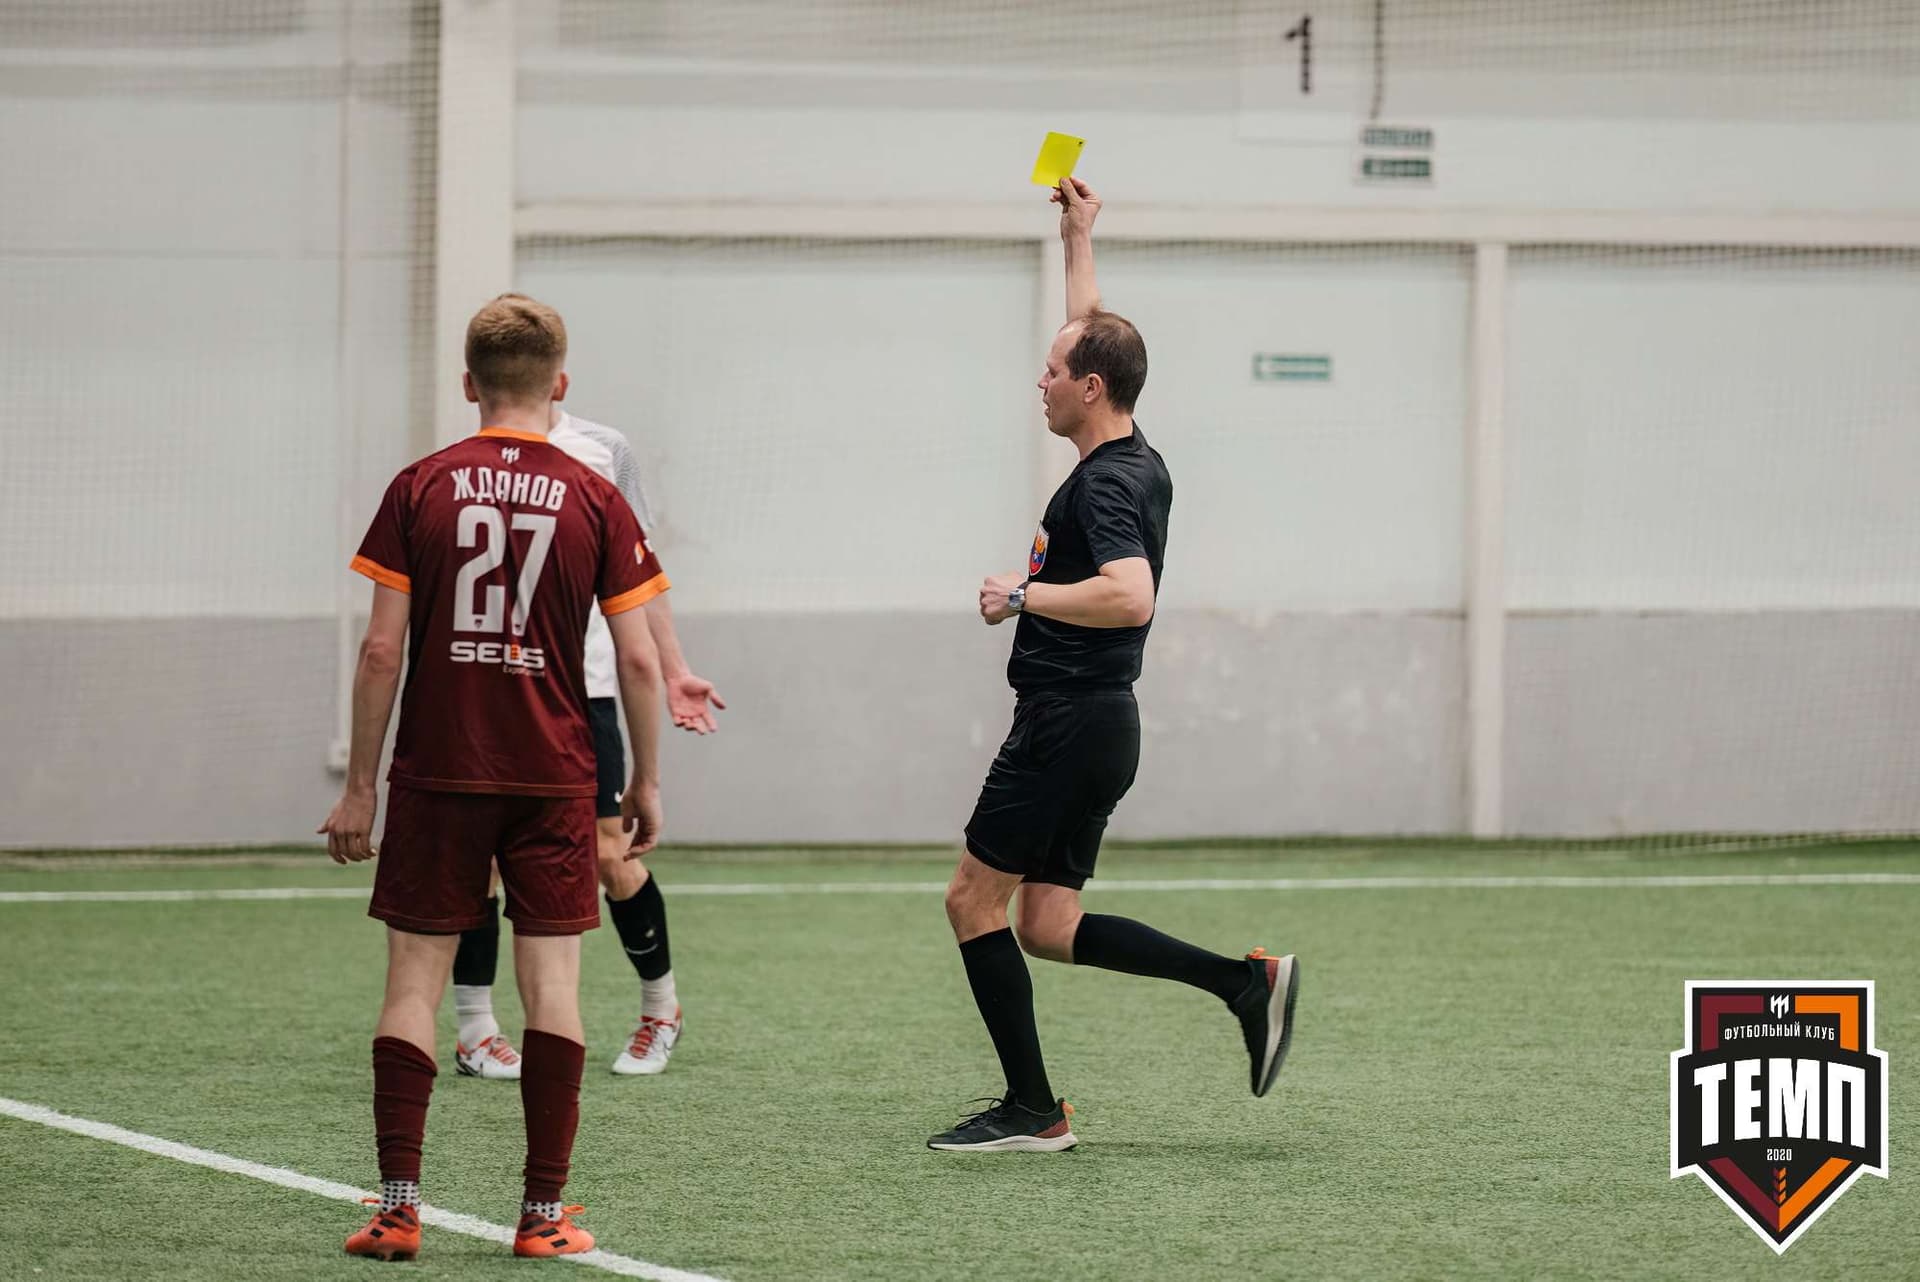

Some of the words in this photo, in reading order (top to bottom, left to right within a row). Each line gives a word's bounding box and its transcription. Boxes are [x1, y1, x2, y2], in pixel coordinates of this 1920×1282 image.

[1284, 14, 1311, 94] 1
[451, 467, 567, 511] ЖДАНОВ
[453, 505, 557, 636] 27
